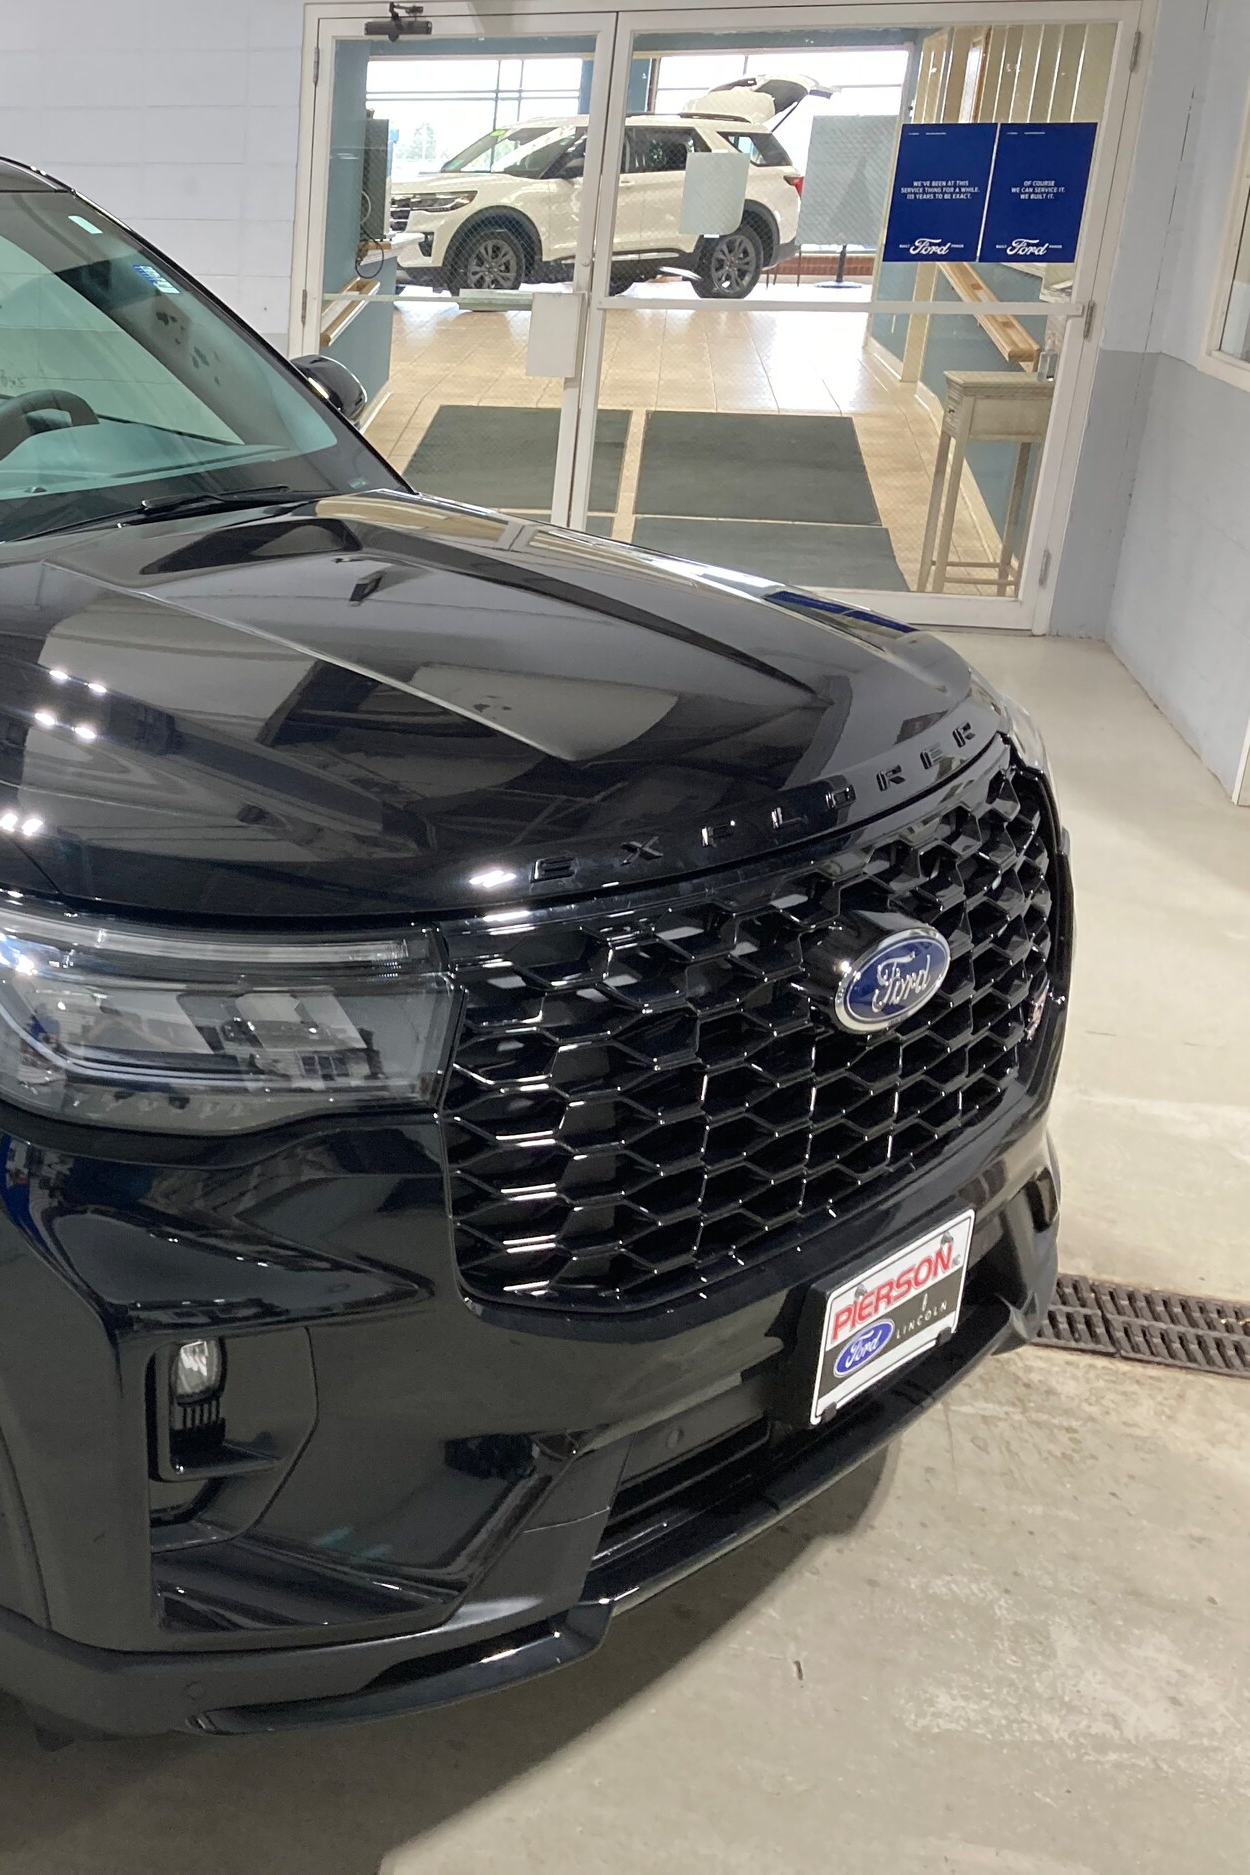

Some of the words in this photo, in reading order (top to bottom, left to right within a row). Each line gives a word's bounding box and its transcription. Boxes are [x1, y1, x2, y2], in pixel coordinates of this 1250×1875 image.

[909, 238, 951, 255] Ford
[1006, 238, 1049, 255] Ford
[529, 720, 976, 884] EXPLORER
[871, 951, 932, 1013] Ford
[831, 1243, 953, 1342] PIERSON
[896, 1300, 948, 1339] LINCOLN
[845, 1330, 883, 1368] Ford
